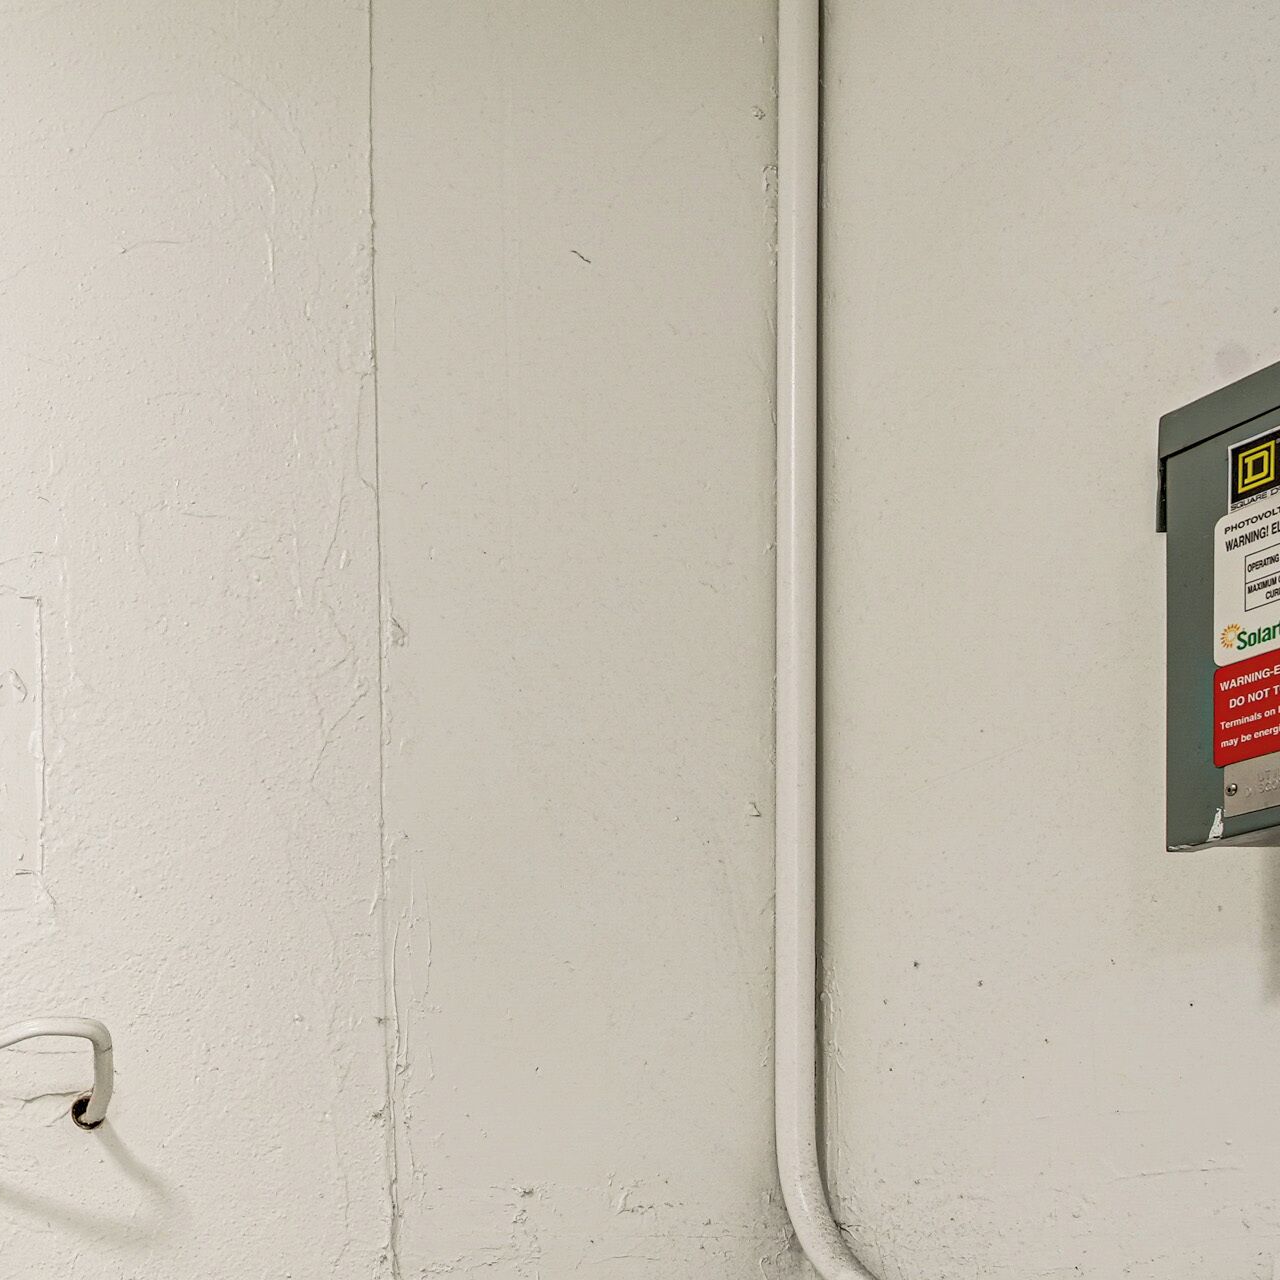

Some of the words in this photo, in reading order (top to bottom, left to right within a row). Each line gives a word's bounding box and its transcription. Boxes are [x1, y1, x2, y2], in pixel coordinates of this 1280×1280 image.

[1230, 492, 1268, 511] SQUARE
[1225, 525, 1269, 552] WARNING!
[1247, 553, 1279, 573] OPERATING
[1247, 576, 1277, 594] MAXIMUM
[1236, 620, 1280, 651] Solar
[1229, 695, 1245, 709] DO
[1247, 688, 1270, 703] NOT
[1220, 711, 1262, 730] Terminals
[1264, 708, 1276, 718] on
[1220, 736, 1239, 748] may
[1241, 733, 1252, 743] be
